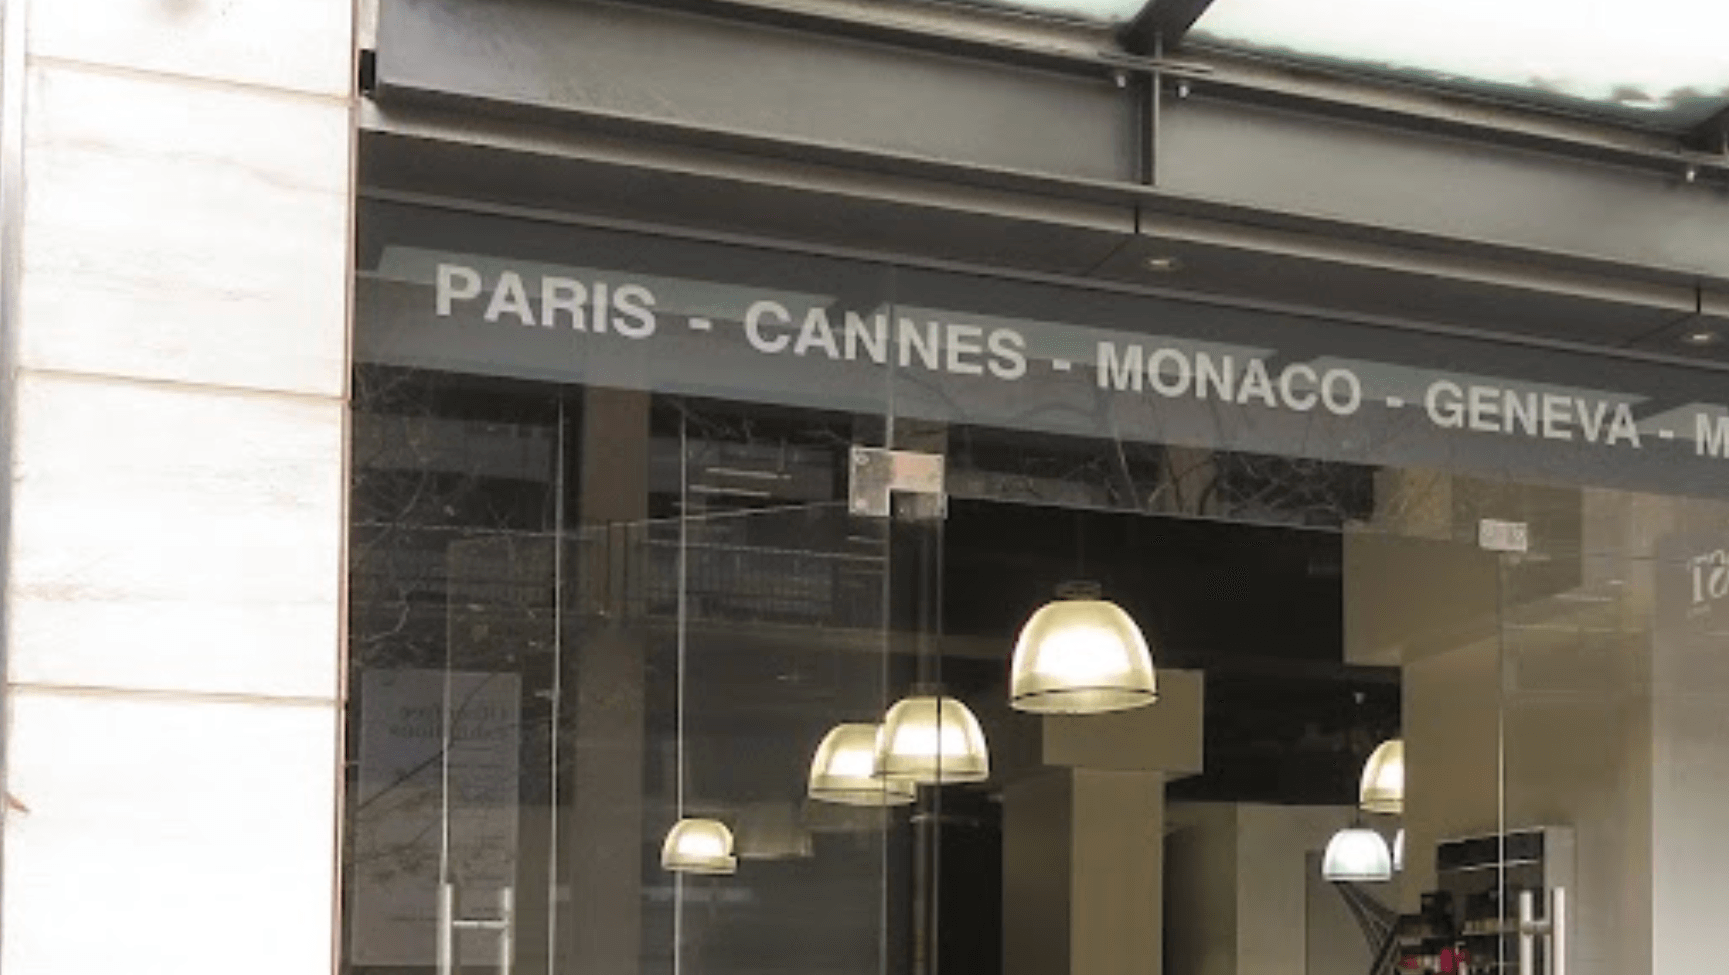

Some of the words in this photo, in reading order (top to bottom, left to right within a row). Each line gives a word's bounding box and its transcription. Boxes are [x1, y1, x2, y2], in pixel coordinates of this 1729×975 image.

[435, 263, 656, 338] PARIS
[744, 301, 1028, 380] CANNES
[1096, 341, 1361, 415] MONACO
[1426, 380, 1640, 448] GENEVA
